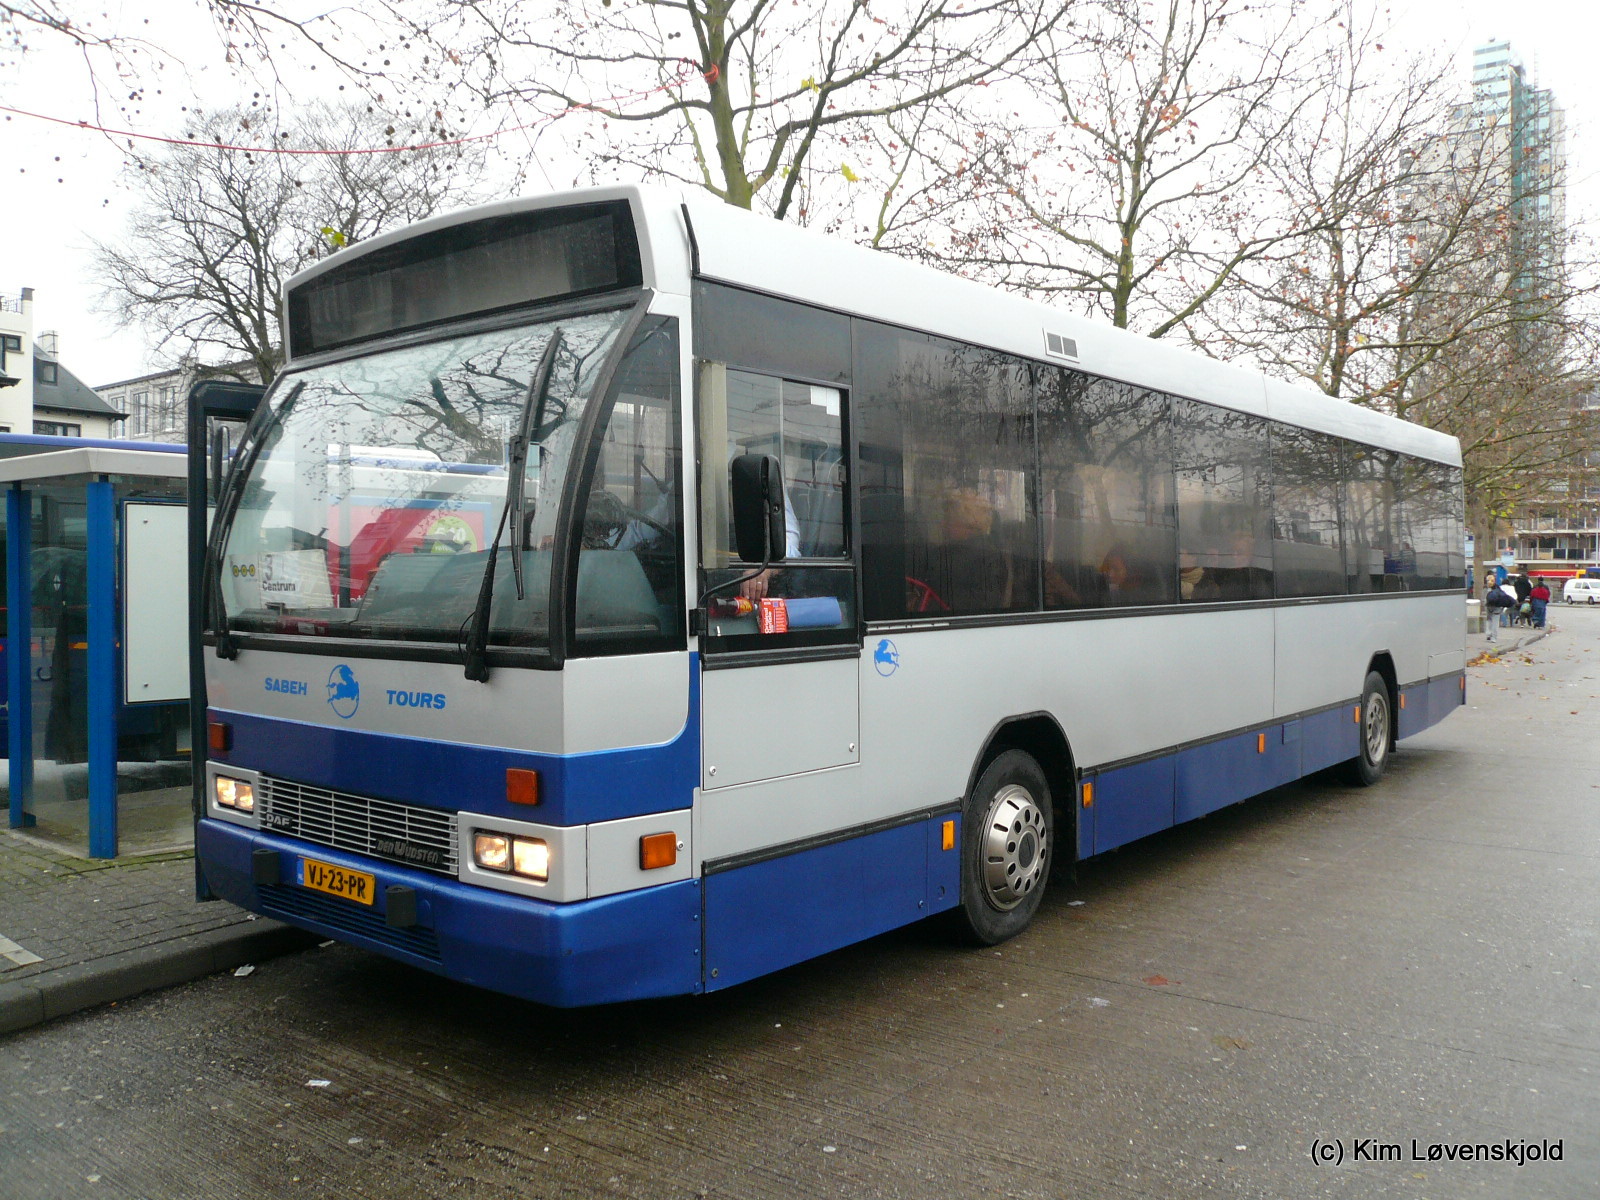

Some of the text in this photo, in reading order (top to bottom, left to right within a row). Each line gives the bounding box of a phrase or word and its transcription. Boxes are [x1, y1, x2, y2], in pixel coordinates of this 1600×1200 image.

[262, 580, 296, 592] Centrum
[264, 677, 446, 710] SABEH TOURS
[265, 813, 291, 829] DAF
[308, 863, 367, 899] VJ-23-PR
